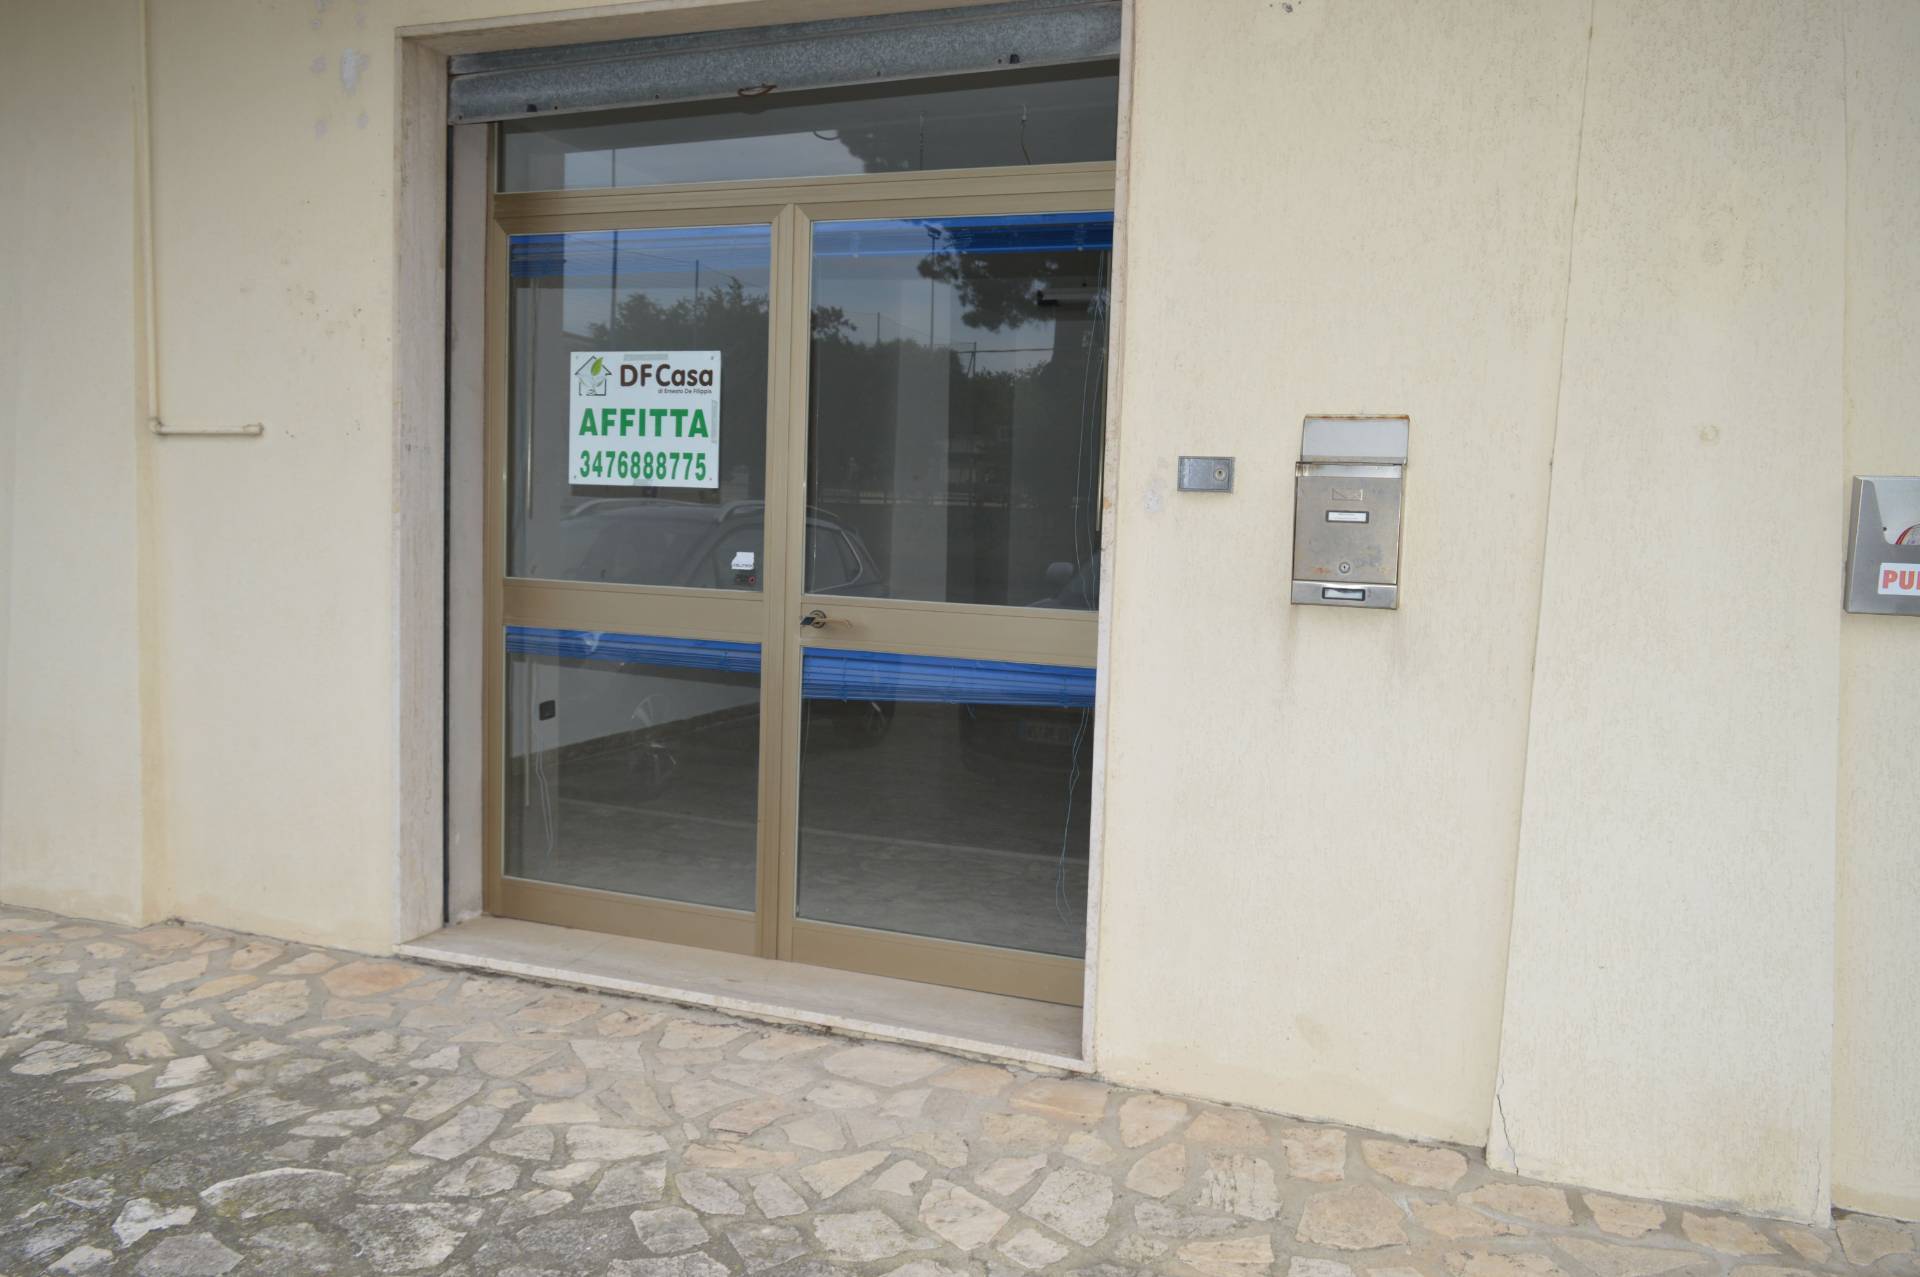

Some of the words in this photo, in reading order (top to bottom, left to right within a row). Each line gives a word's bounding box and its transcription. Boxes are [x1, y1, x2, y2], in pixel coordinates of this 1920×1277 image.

[578, 407, 709, 438] AFFITTA
[579, 449, 707, 481] 3476888775
[1881, 569, 1920, 591] PU
